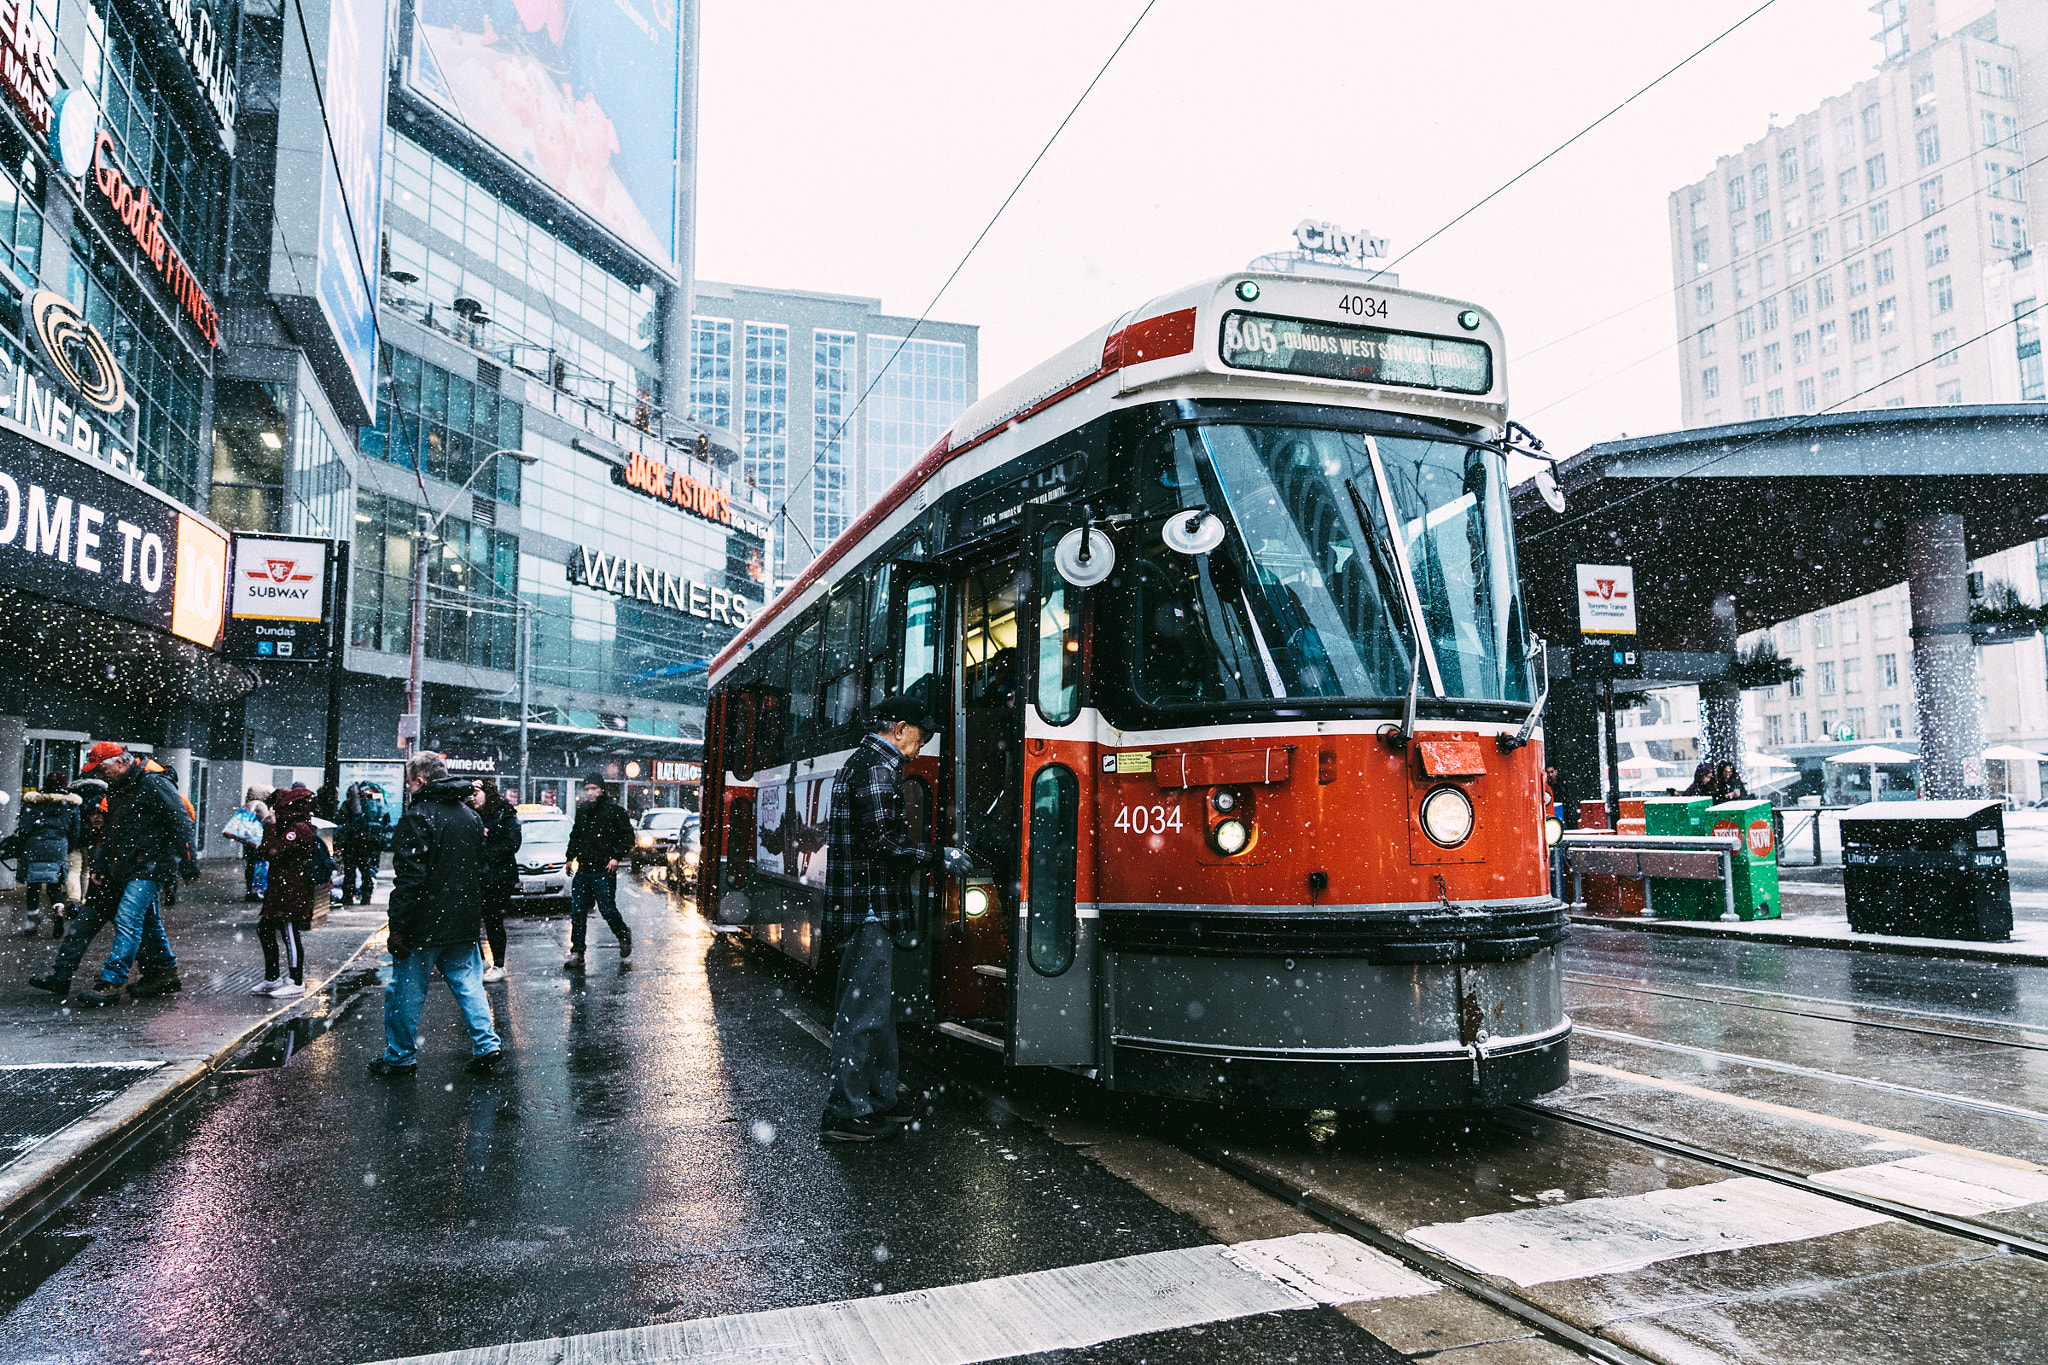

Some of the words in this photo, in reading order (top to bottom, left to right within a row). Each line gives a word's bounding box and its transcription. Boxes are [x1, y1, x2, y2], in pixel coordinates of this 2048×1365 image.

[4, 46, 56, 133] MART
[1295, 218, 1391, 260] Citytv
[166, 247, 219, 348] FITNESS
[1338, 294, 1388, 319] 4034
[1283, 331, 1338, 355] DUNDAS
[1338, 337, 1377, 359] WEST
[1378, 342, 1401, 363] STN
[1400, 345, 1426, 365] VIA
[1427, 347, 1479, 371] DUNDAS
[625, 451, 668, 499] JACK
[670, 471, 731, 525] ASTOR'S
[0, 470, 105, 573] OME
[117, 519, 164, 593] TO
[181, 543, 220, 622] 10
[248, 585, 309, 599] SUBWAY
[580, 544, 750, 630] WINNERS
[255, 625, 296, 637] Dundas
[1584, 637, 1611, 646] Dundas
[446, 758, 473, 770] wine
[1114, 805, 1184, 834] 4034
[1749, 828, 1771, 849] NOW
[1847, 853, 1866, 864] Litter
[1977, 854, 1993, 866] Litter
